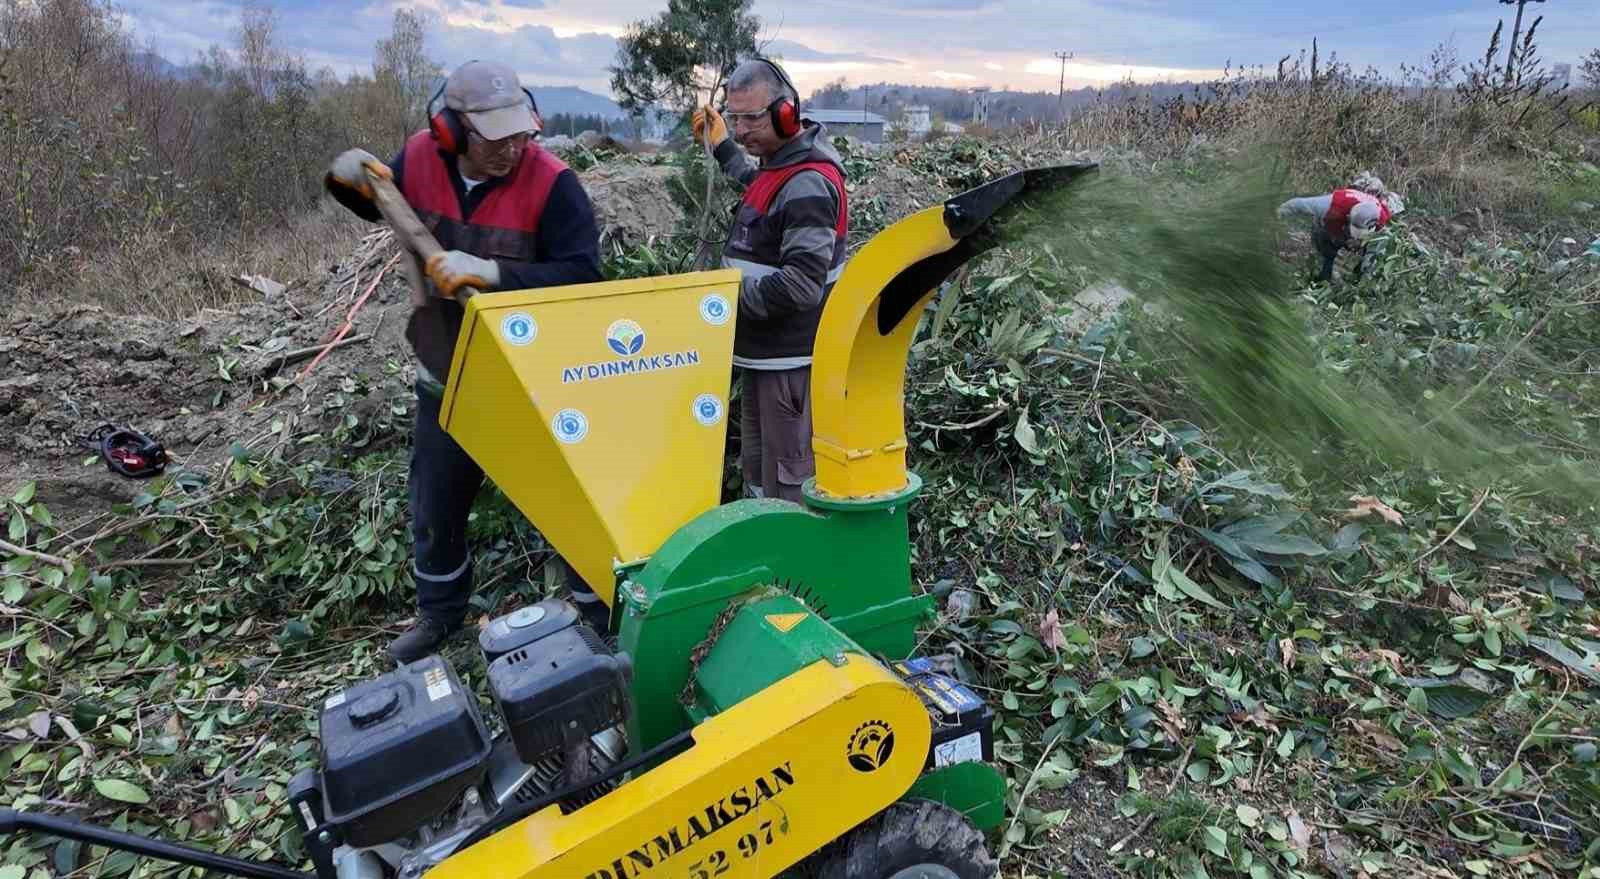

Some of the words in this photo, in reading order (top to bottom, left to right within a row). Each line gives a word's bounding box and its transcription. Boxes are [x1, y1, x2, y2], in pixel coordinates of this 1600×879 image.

[562, 350, 699, 383] AYDINMAKSAN
[688, 850, 730, 879] 52
[737, 819, 774, 858] 97
